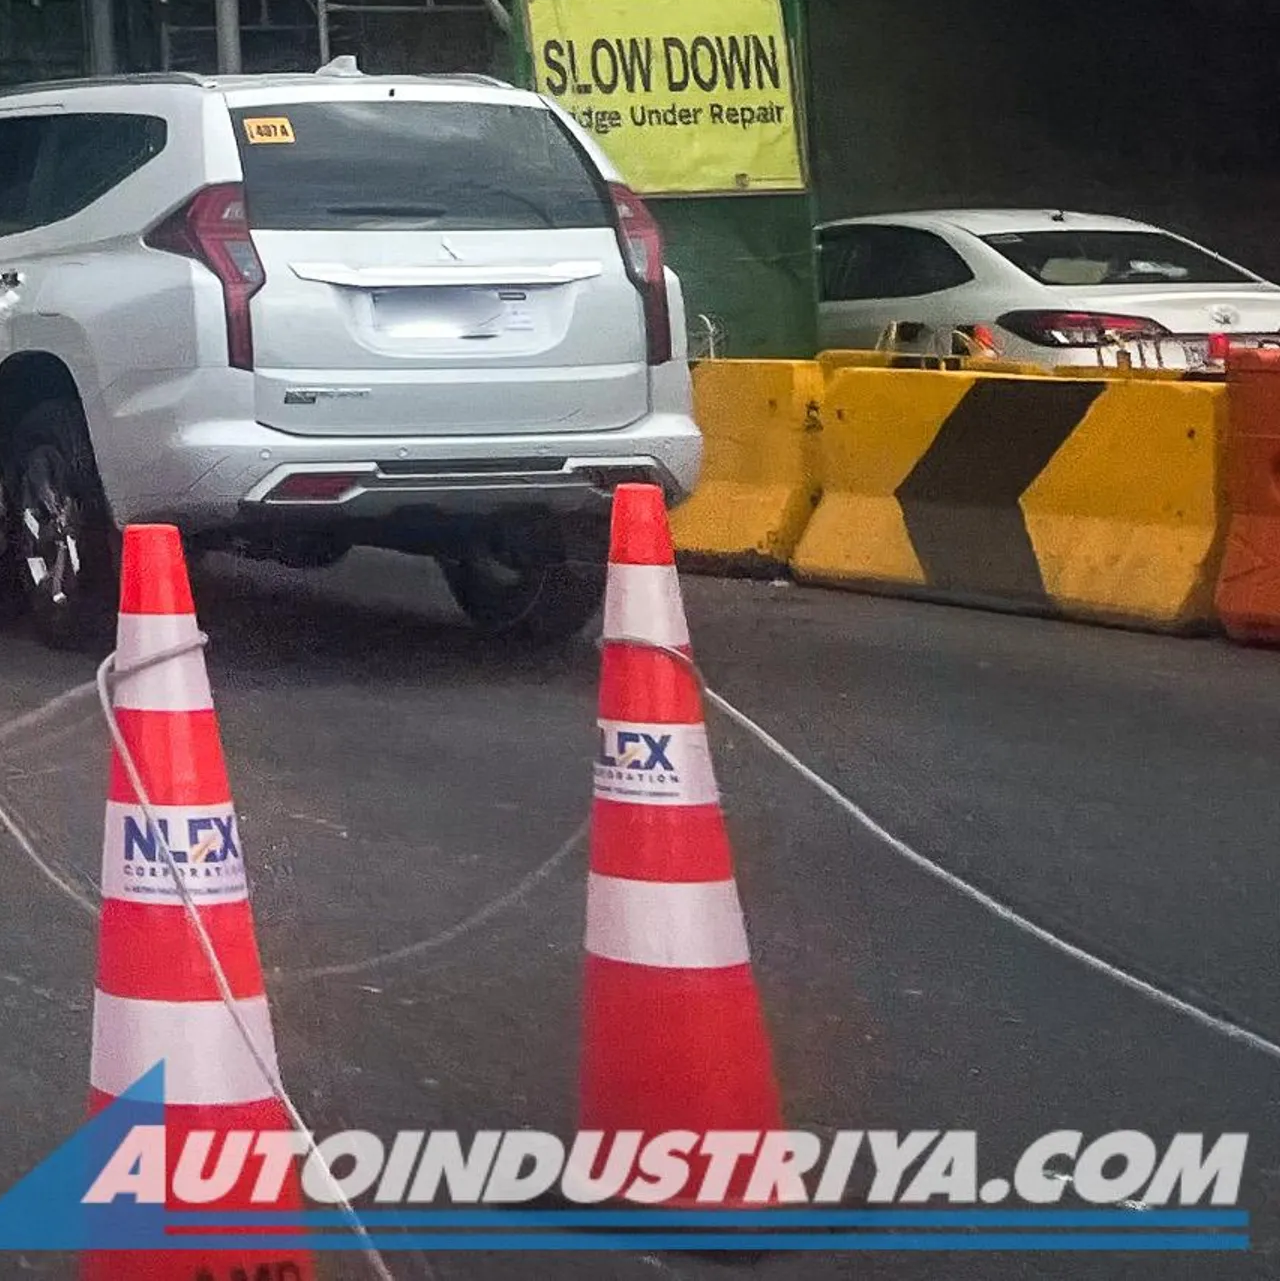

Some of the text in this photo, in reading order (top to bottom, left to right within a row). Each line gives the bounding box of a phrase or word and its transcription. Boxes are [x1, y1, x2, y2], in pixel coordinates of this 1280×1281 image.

[543, 34, 781, 96] SLOW DOWN
[629, 103, 704, 128] Under
[709, 102, 785, 130] Repair
[598, 727, 675, 772] LEX
[123, 815, 239, 863] NLEX
